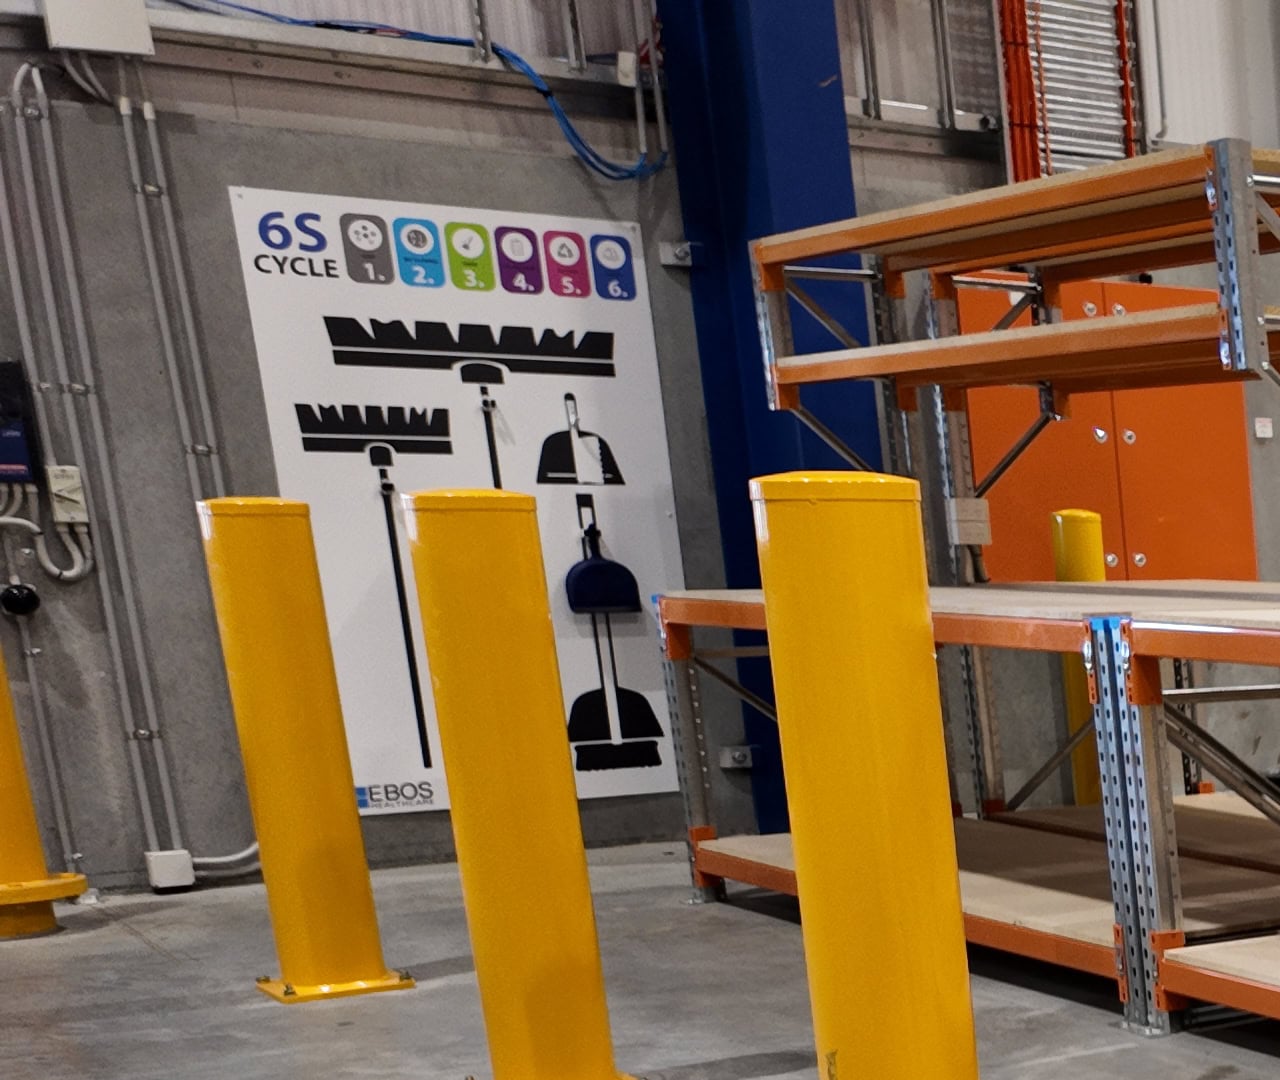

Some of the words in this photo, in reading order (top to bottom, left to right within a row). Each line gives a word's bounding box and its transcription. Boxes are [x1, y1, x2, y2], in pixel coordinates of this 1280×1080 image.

[258, 211, 328, 253] 6S
[254, 254, 340, 278] CYCLE
[368, 782, 434, 802] EBOS
